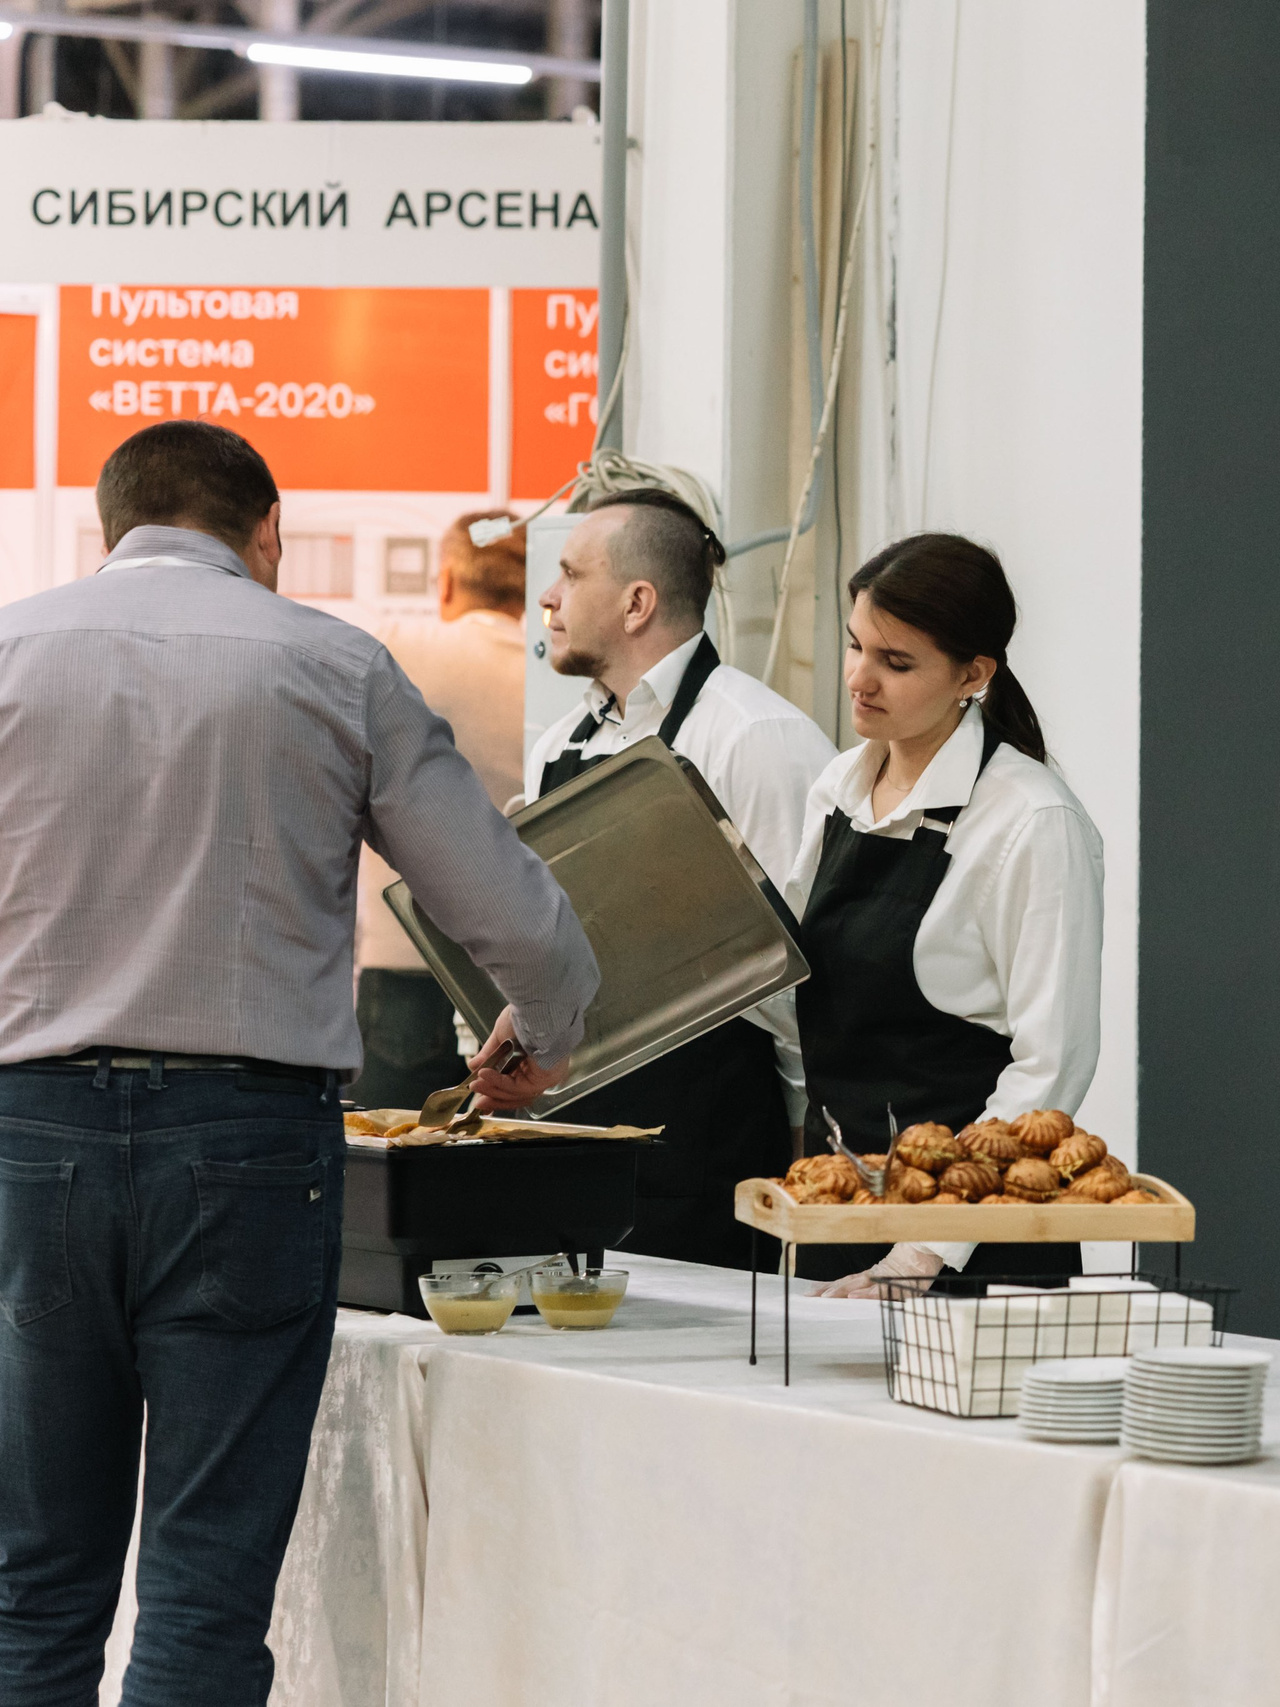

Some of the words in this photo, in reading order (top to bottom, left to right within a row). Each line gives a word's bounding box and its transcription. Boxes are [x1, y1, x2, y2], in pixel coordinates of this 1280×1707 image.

[32, 180, 348, 228] СИБИРСКИЙ
[385, 190, 599, 228] АРСЕНА
[91, 284, 299, 327] Пультовая
[89, 337, 254, 368] система
[89, 380, 376, 419] «ВЕТТА-2020»
